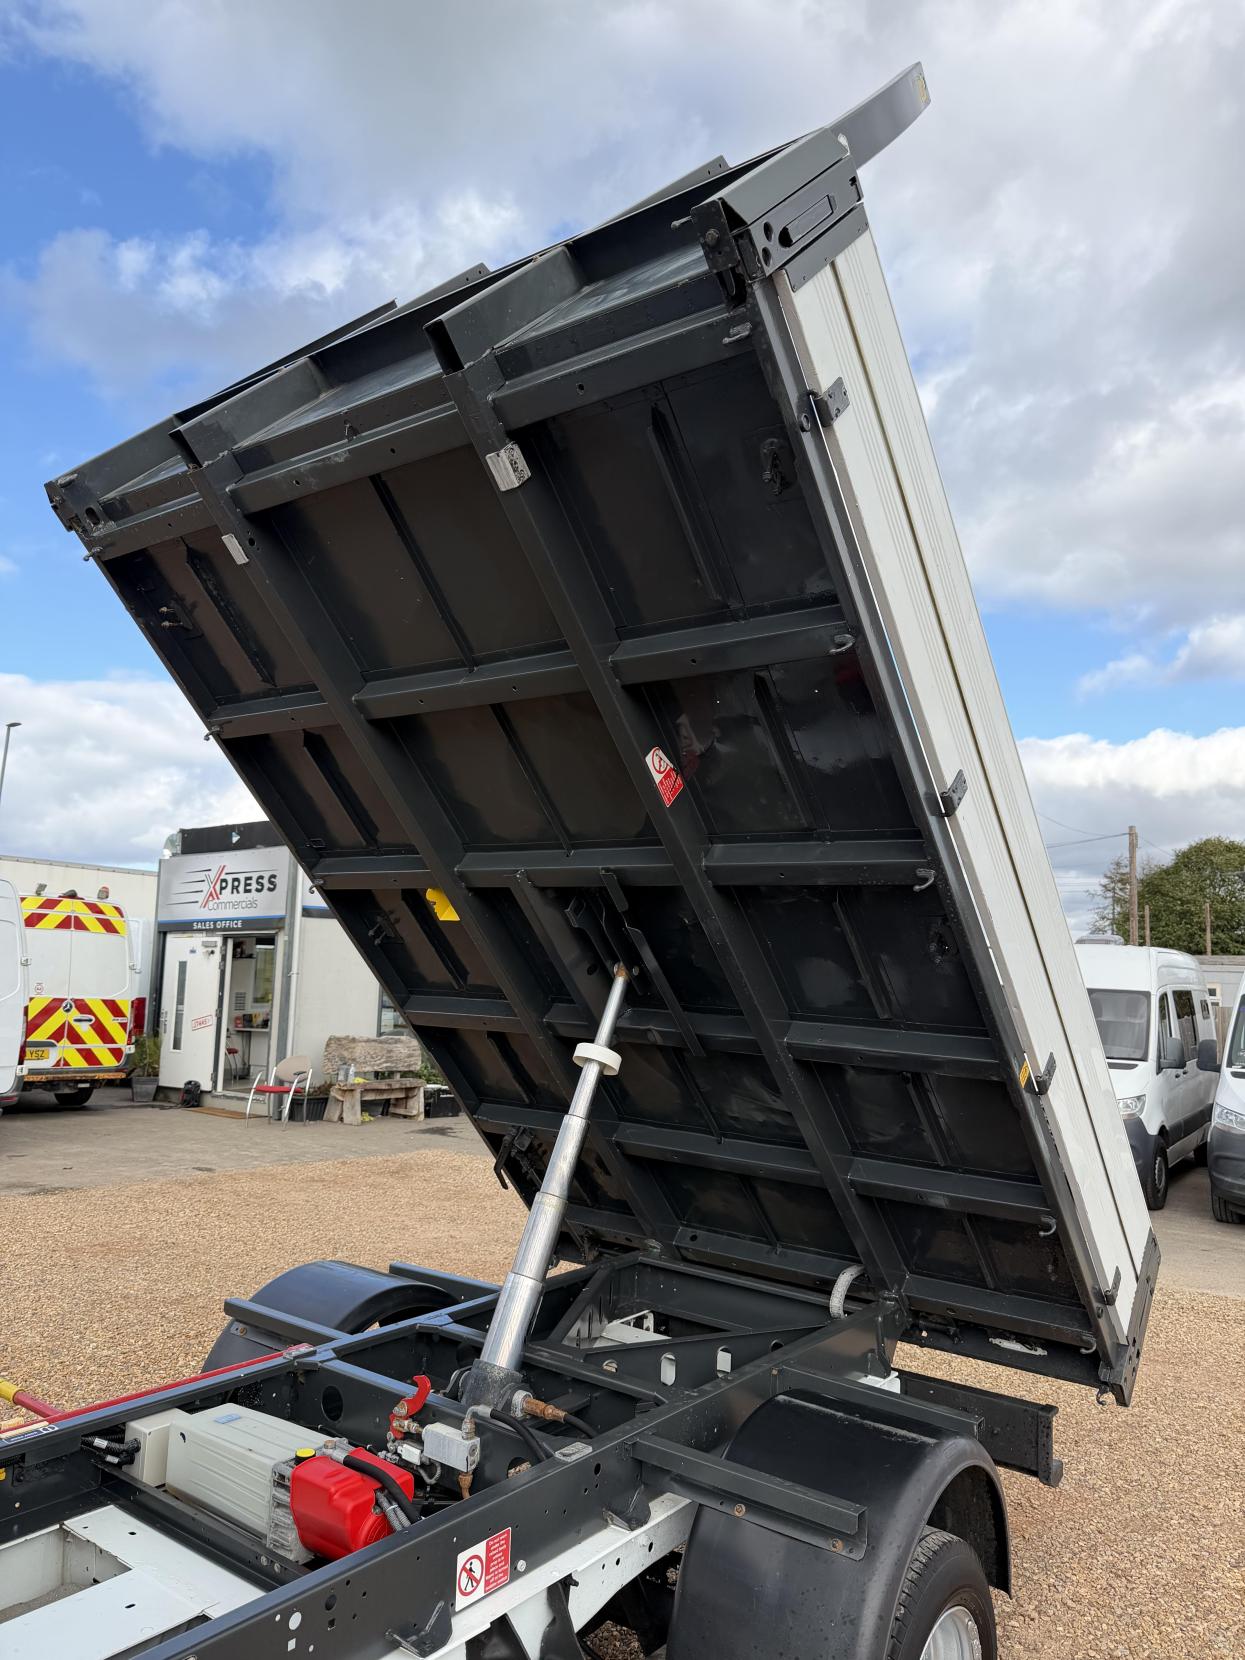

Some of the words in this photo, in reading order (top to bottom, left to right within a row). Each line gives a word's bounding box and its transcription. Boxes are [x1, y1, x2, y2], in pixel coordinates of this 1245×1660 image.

[200, 865, 277, 908] XPRESS
[208, 897, 258, 911] Commercials
[193, 921, 214, 929] SALES
[216, 920, 242, 929] OFFICE
